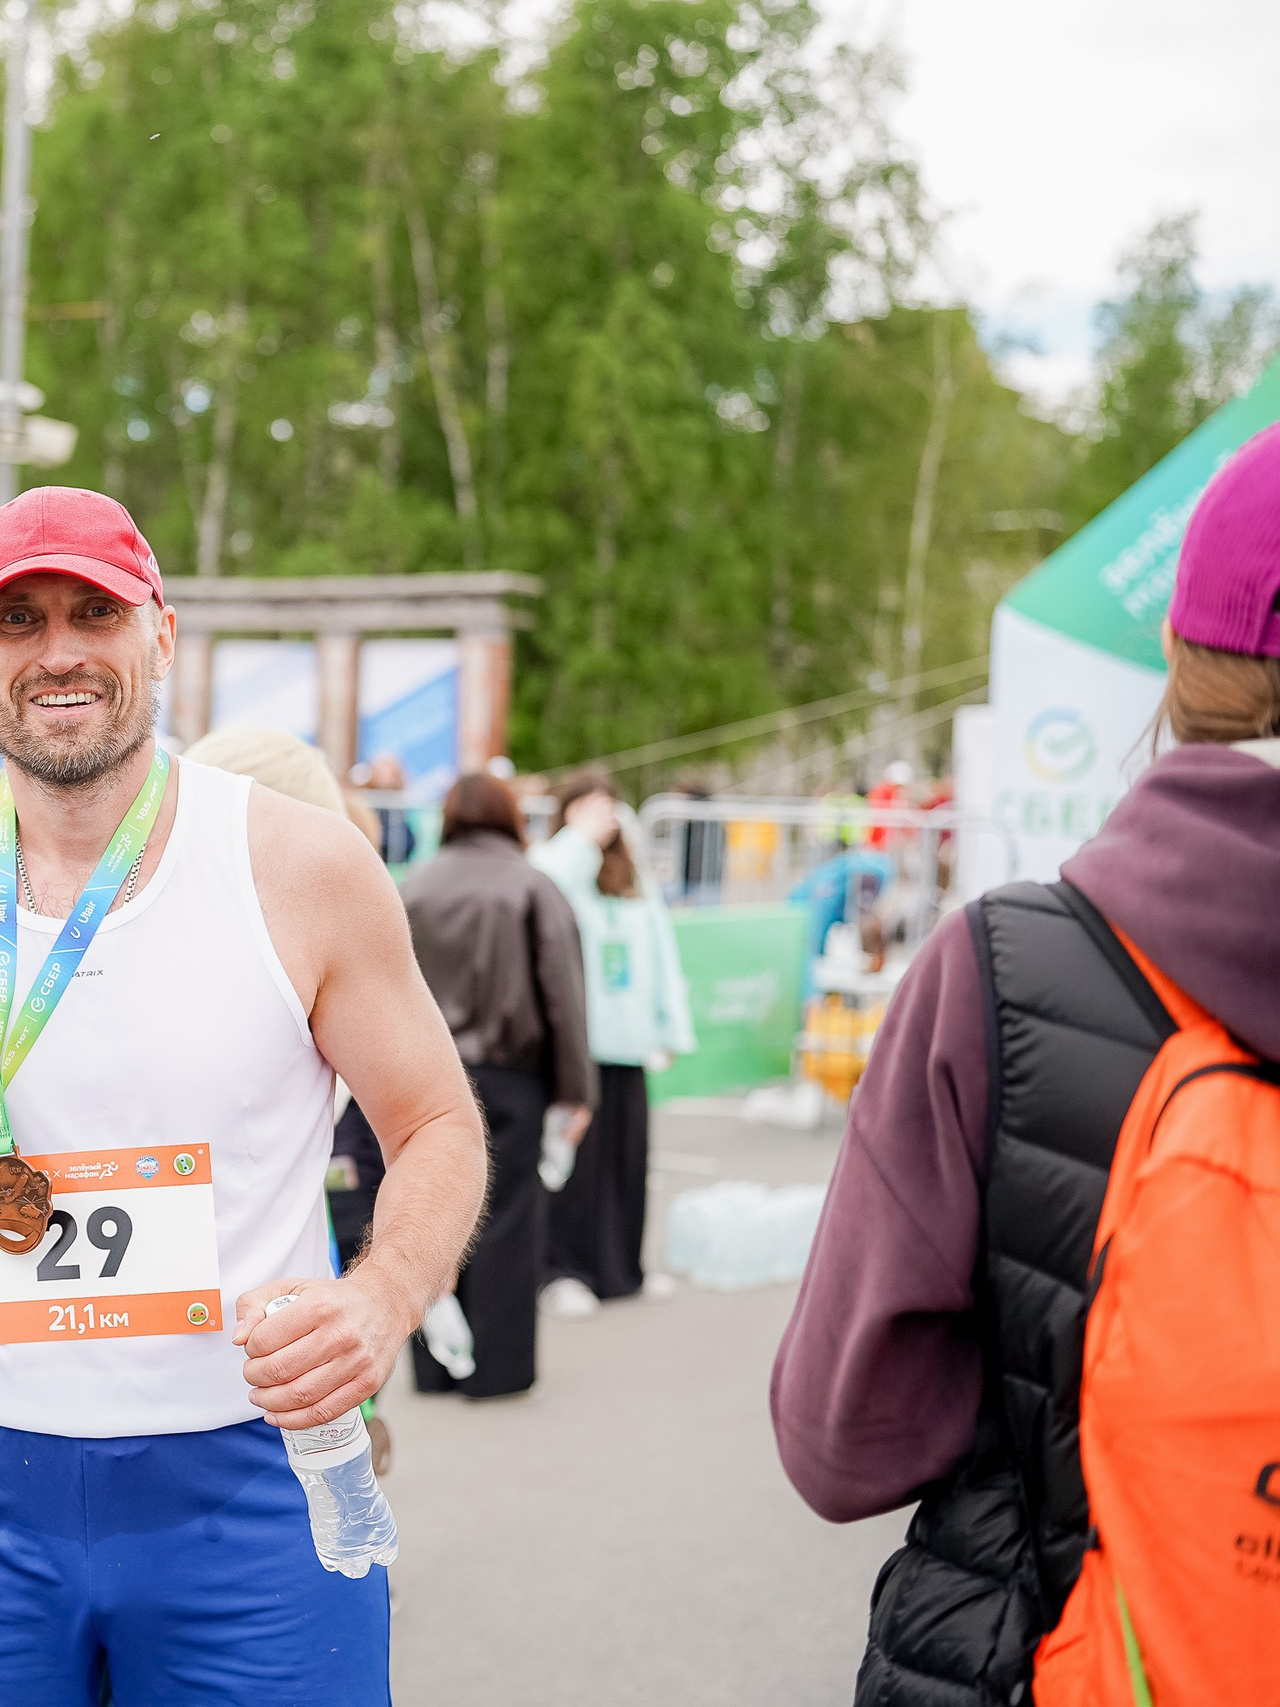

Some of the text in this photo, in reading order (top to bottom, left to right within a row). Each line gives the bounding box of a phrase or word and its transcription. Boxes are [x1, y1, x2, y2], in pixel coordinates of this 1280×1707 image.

[136, 800, 151, 821] 185
[77, 899, 96, 925] Utair
[40, 962, 62, 996] СБЕР
[72, 969, 104, 978] ATRIX
[15, 1026, 29, 1048] лет
[65, 1170, 100, 1179] марафон
[37, 1205, 133, 1281] 29
[48, 1303, 95, 1334] 21,1
